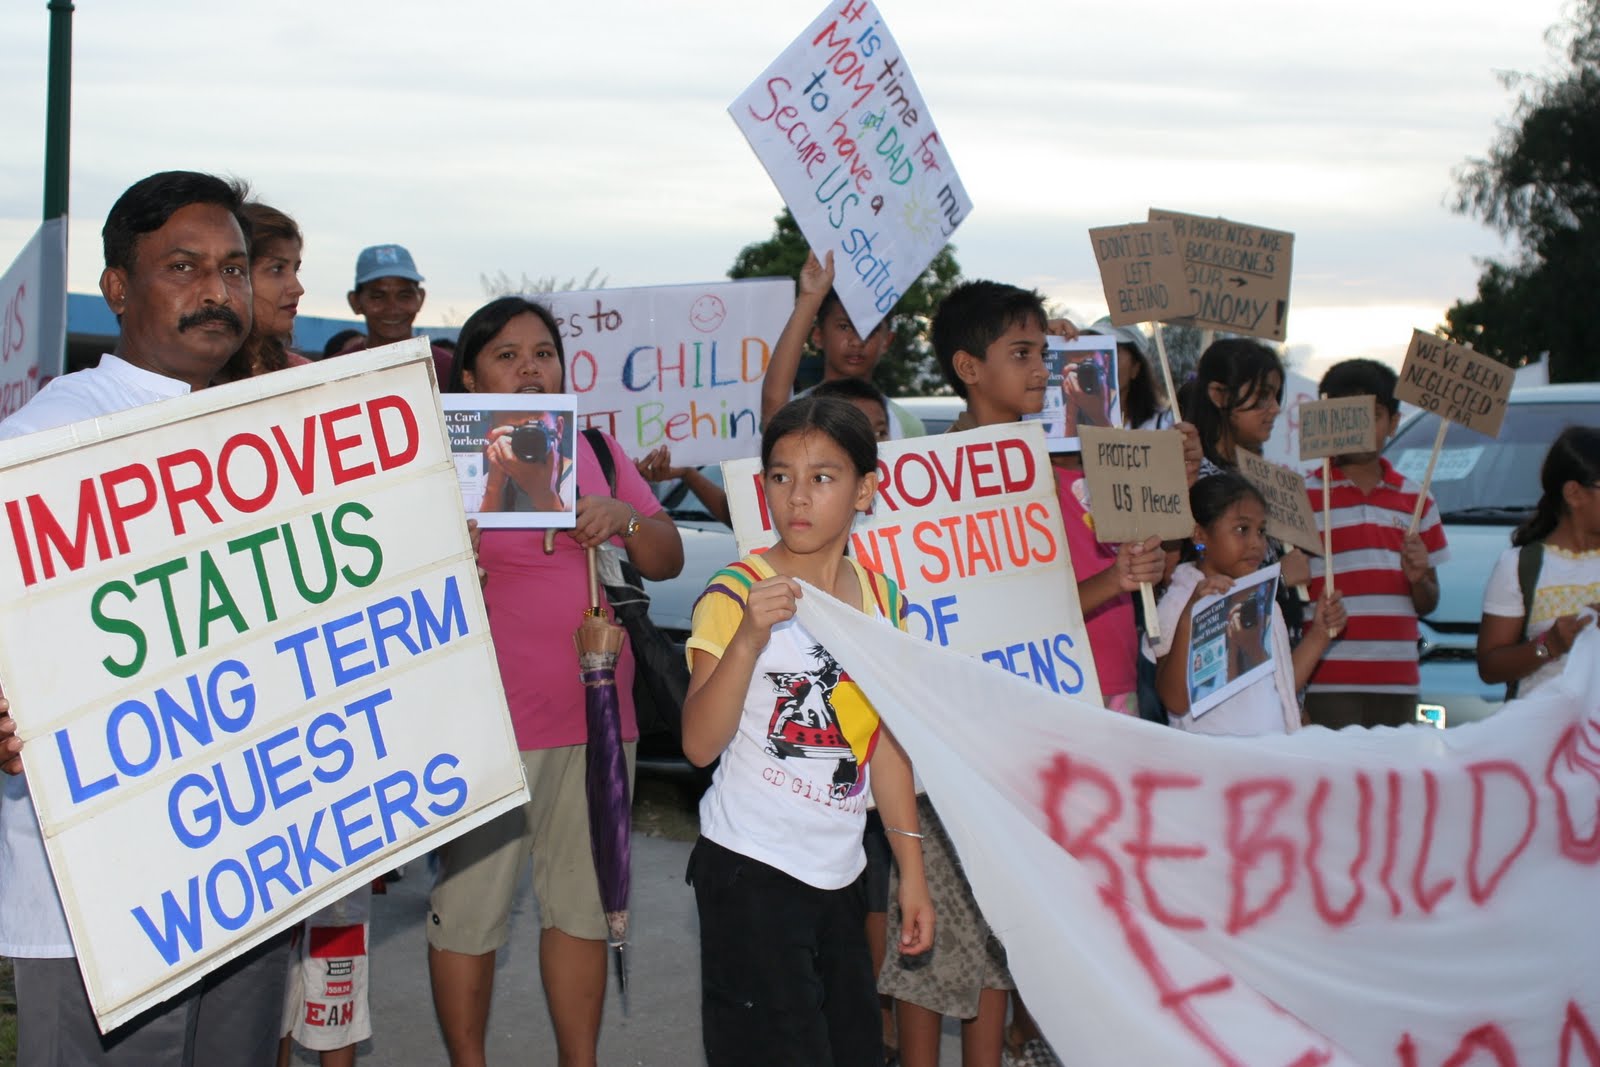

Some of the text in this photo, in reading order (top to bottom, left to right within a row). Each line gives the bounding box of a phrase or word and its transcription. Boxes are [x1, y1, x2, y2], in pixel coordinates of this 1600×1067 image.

[748, 77, 826, 179] Secure
[803, 69, 829, 112] to
[826, 110, 873, 195] have
[812, 20, 876, 109] MOM
[876, 126, 914, 185] DAD
[857, 19, 881, 58] is
[877, 57, 919, 128] time
[913, 131, 941, 173] for
[937, 184, 965, 237] my
[587, 299, 623, 333] to
[1118, 284, 1169, 313] BEHIND
[621, 336, 771, 392] CHILD
[1415, 339, 1504, 392] WE'VE BEEN
[455, 412, 480, 421] Card
[635, 399, 763, 448] Behin
[1418, 393, 1473, 427] SO FAR
[4, 394, 420, 588] IMPROVED
[1098, 443, 1151, 471] PROTECT
[1112, 484, 1182, 515] US Please
[912, 502, 1058, 584] STATUS
[90, 501, 384, 679] STATUS
[55, 576, 469, 805] LONG TERM
[167, 688, 393, 850] GUEST
[131, 753, 469, 967] WORKERS
[1037, 750, 1538, 937] REBUILD
[304, 1000, 354, 1027] EAM
